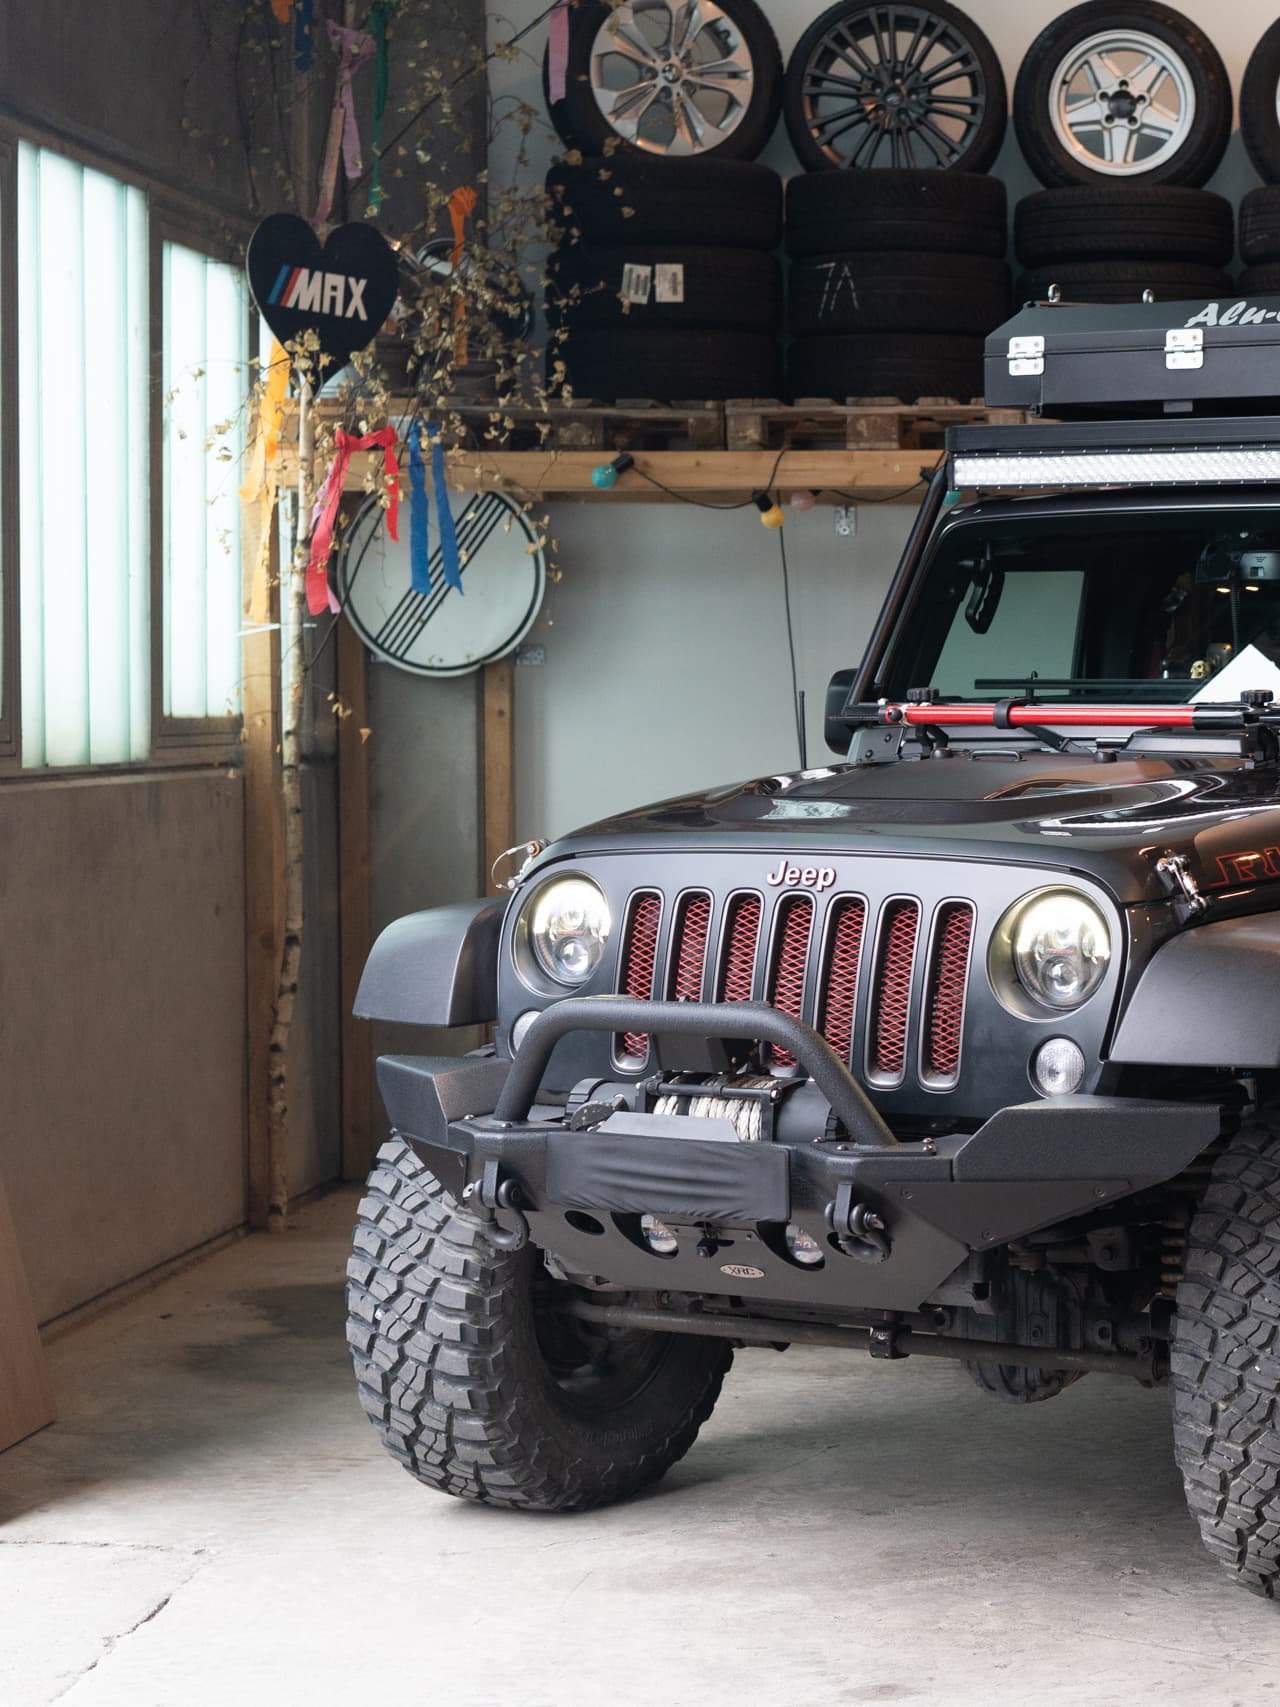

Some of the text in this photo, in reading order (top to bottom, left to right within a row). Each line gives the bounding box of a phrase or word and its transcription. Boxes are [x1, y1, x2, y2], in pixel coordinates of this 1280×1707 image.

[286, 267, 368, 321] MAX
[767, 860, 837, 892] Jeep
[728, 1266, 756, 1275] XRC
